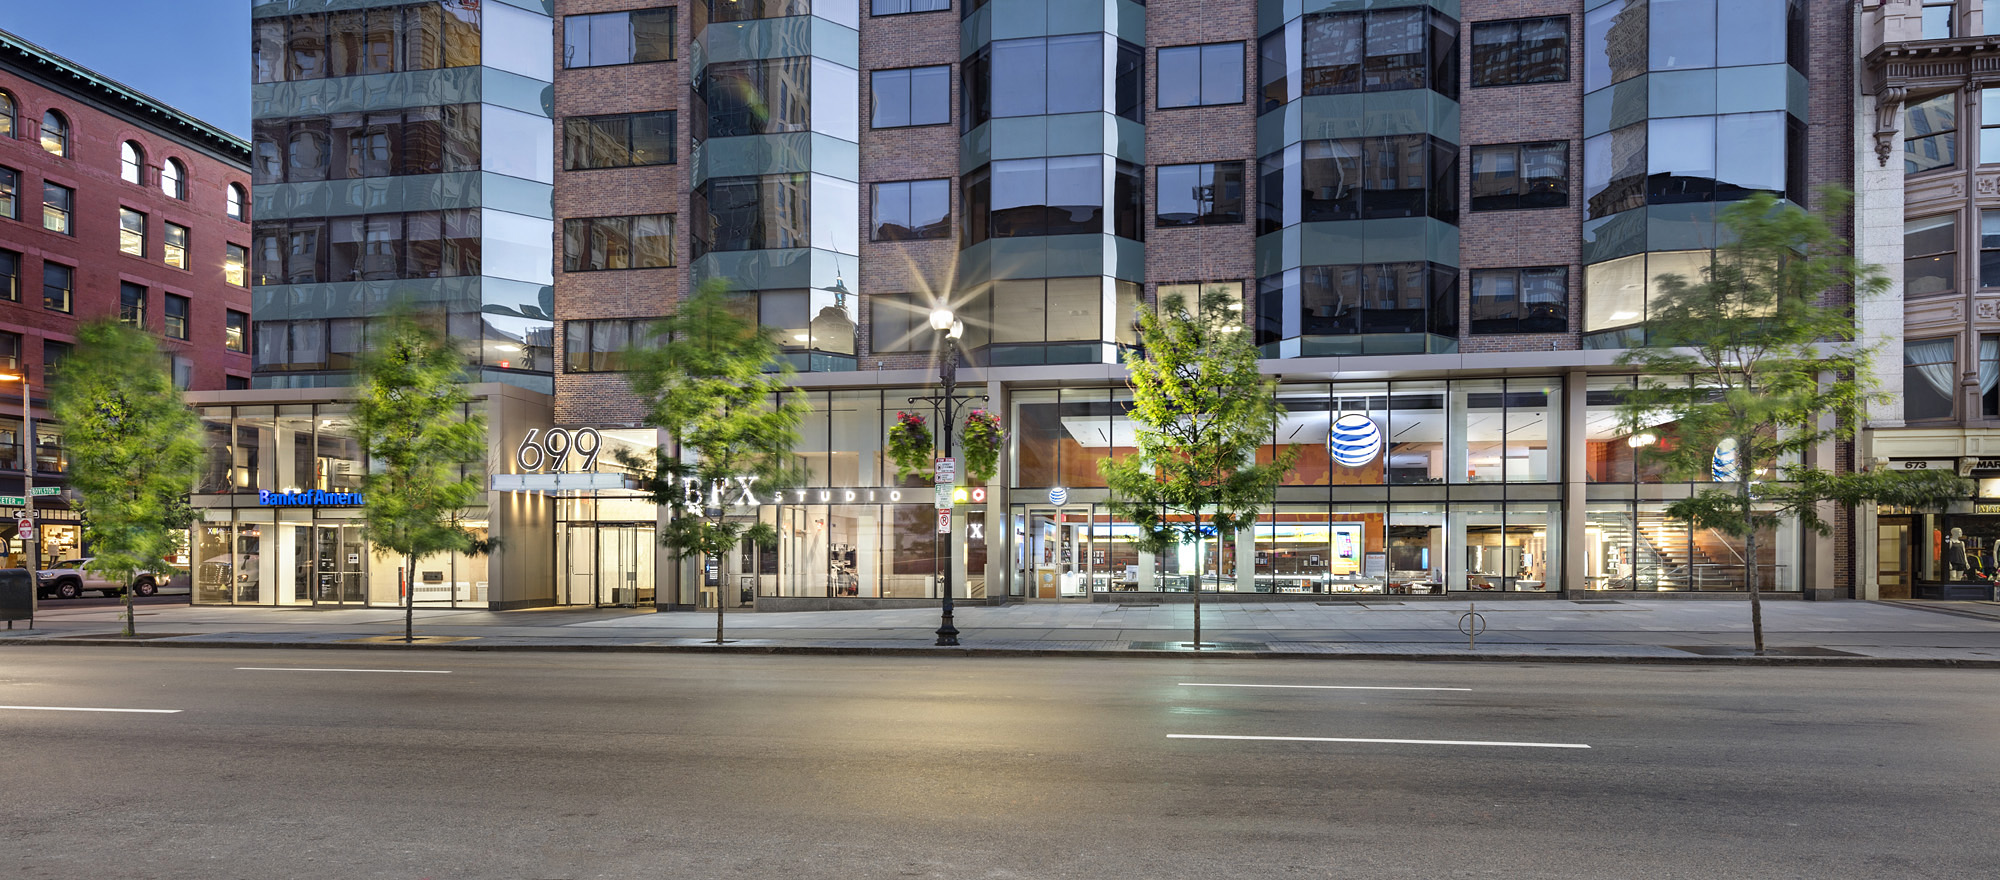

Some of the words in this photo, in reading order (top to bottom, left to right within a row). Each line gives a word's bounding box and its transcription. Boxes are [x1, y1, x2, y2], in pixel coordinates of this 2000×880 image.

[517, 427, 602, 471] 699
[1905, 461, 1927, 469] 673
[259, 489, 297, 506] Bank
[297, 489, 313, 506] of
[314, 488, 366, 506] Americ
[774, 490, 901, 502] STUDIO
